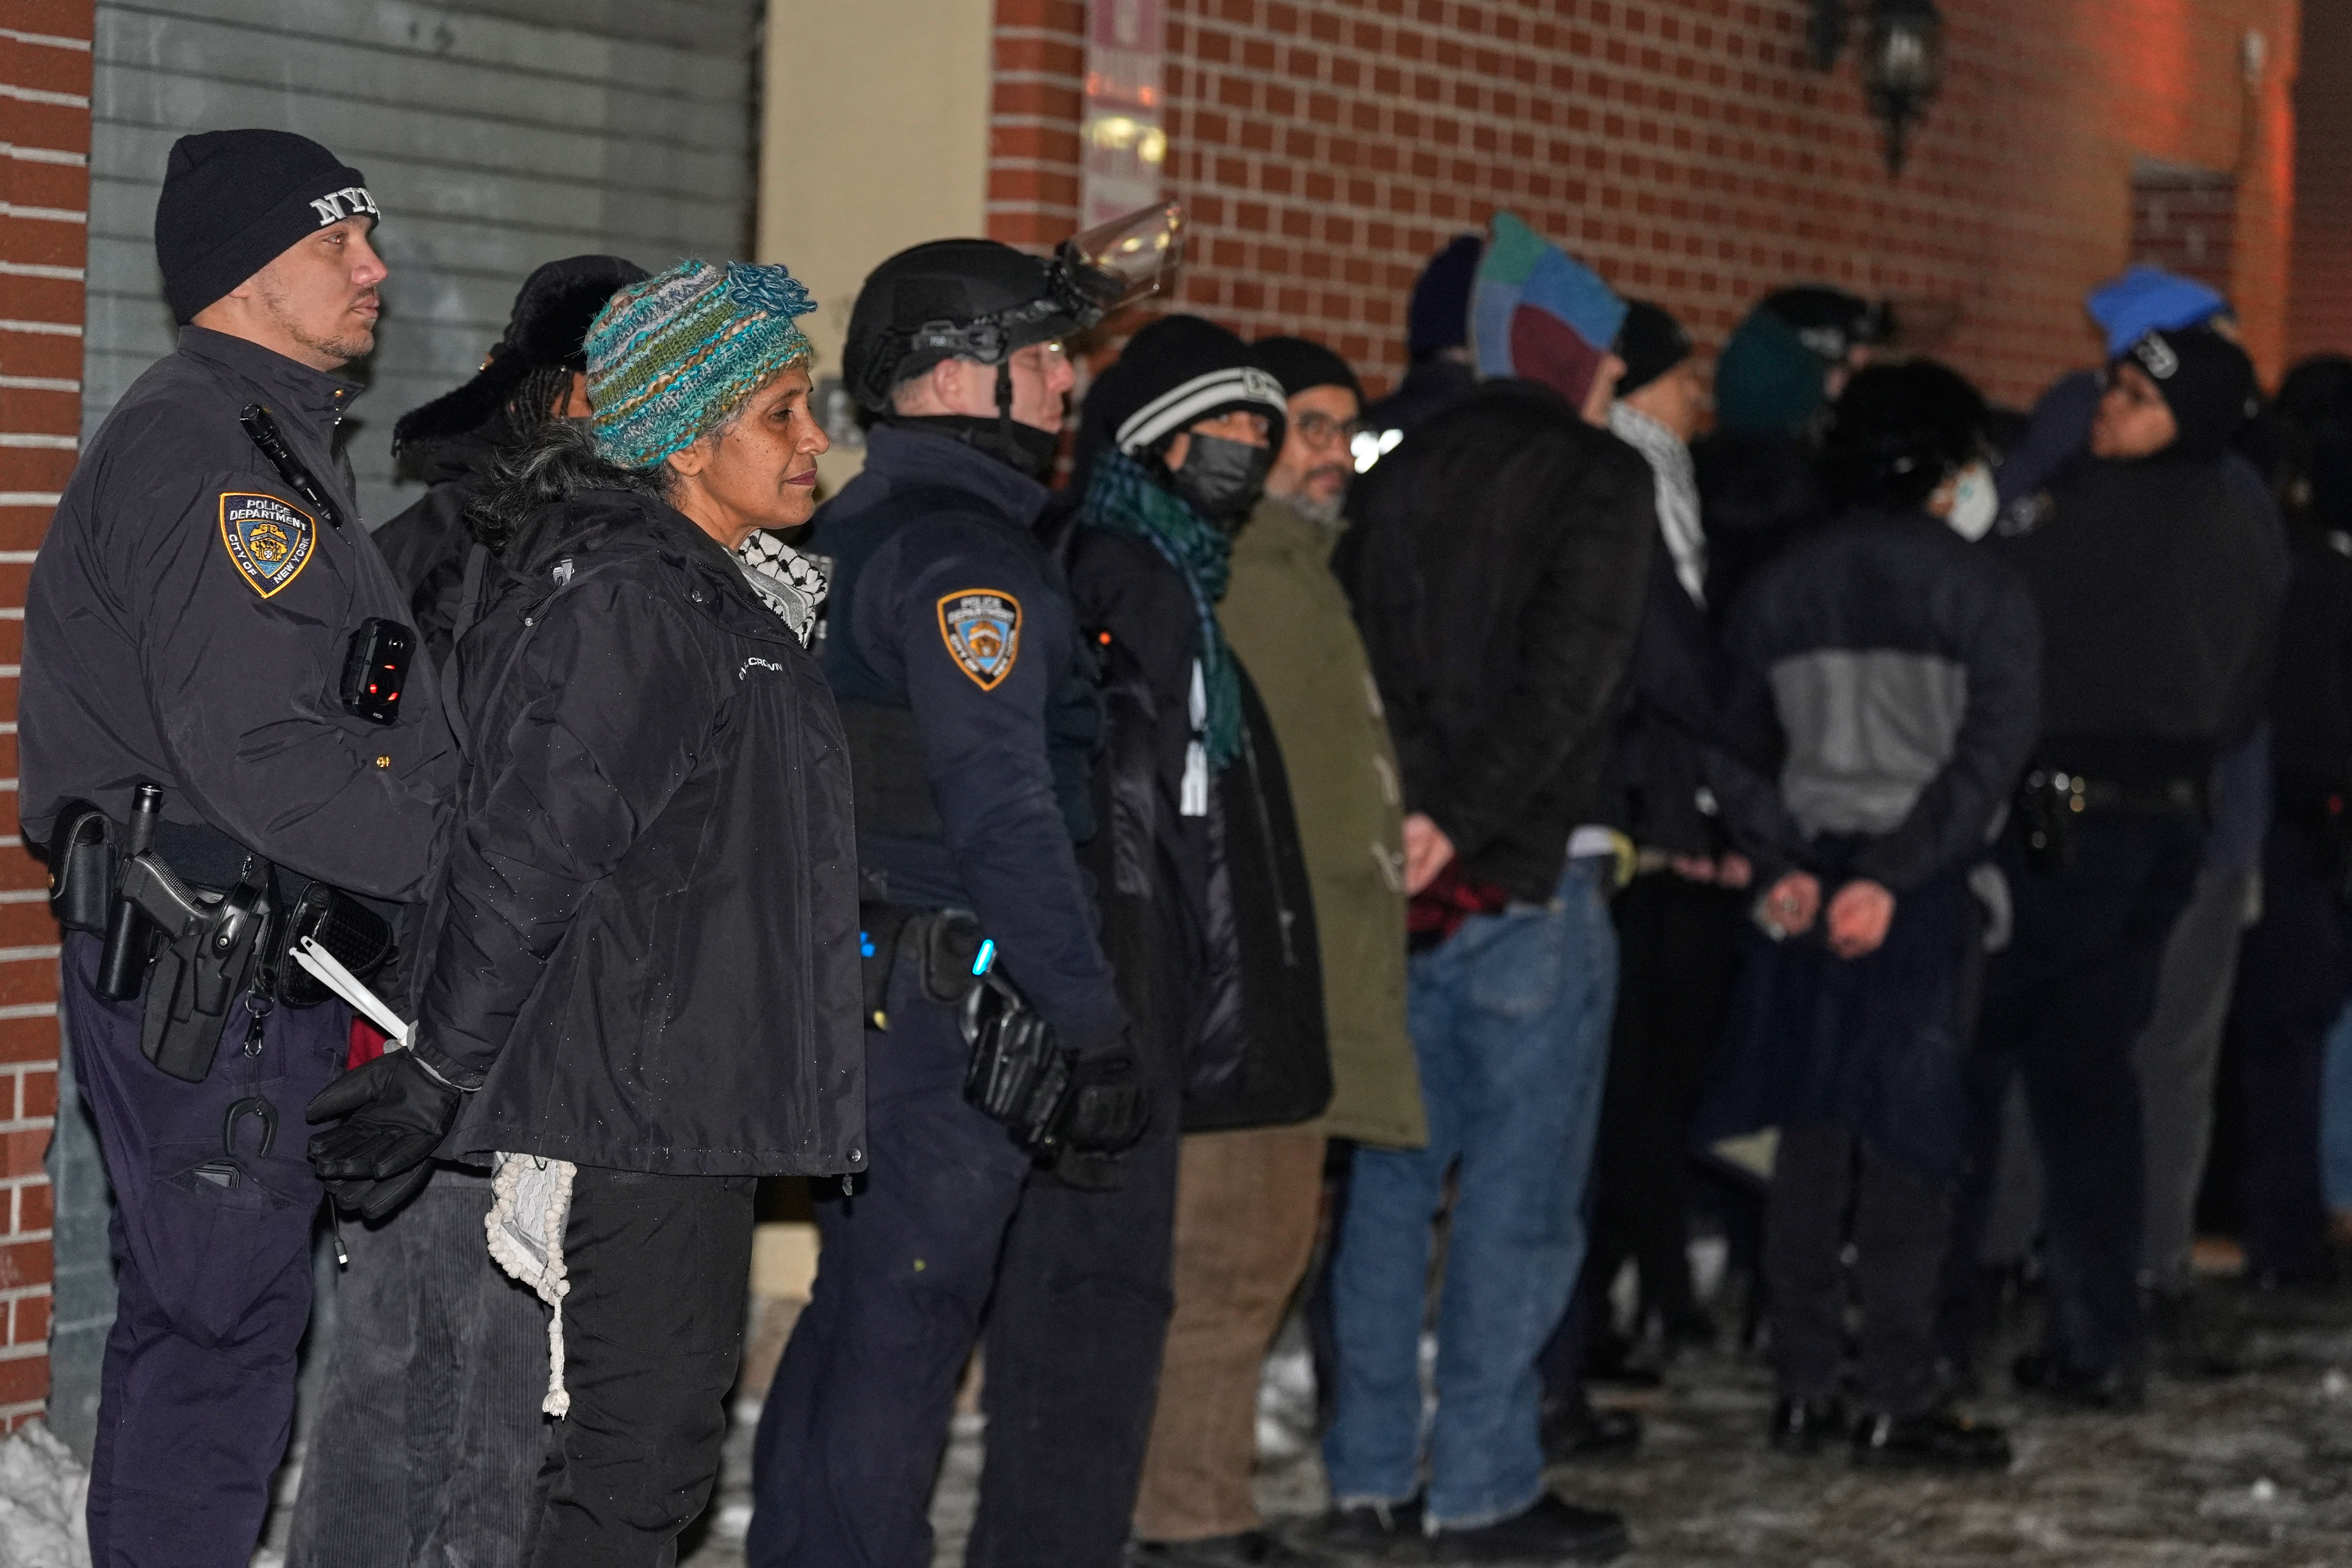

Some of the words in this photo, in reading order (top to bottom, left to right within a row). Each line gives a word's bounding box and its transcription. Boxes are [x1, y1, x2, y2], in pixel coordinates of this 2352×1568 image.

[230, 509, 307, 531] DEPARTMENT
[247, 500, 291, 516] POLICE
[229, 534, 247, 559] CITY
[243, 562, 257, 575] OF
[273, 563, 294, 584] NEW
[291, 537, 310, 563] YORK
